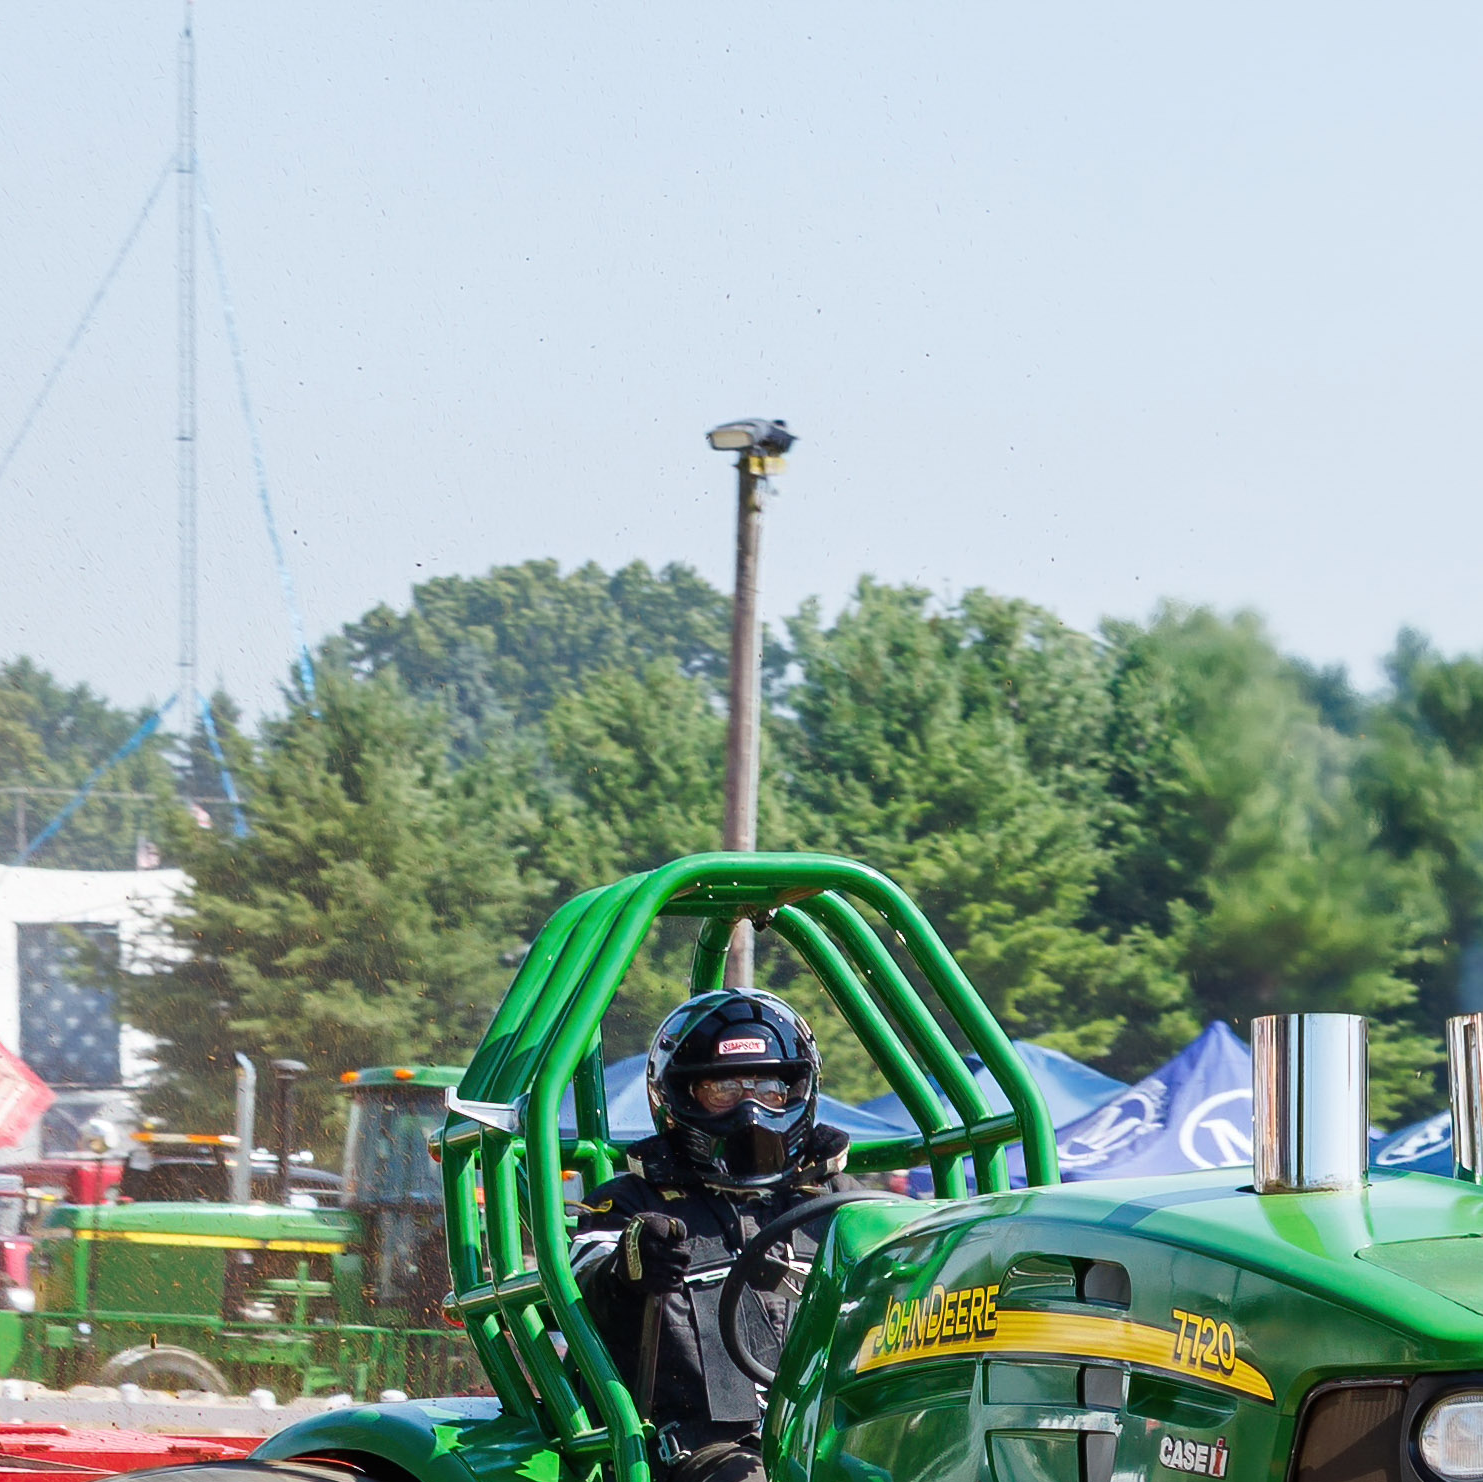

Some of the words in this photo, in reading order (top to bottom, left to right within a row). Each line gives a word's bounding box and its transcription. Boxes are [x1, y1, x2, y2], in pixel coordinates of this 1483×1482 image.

[875, 1293, 929, 1358] JOHN
[925, 1285, 1000, 1341] DEERE
[1172, 1308, 1236, 1374] 7720
[1159, 1436, 1211, 1475] CASE
